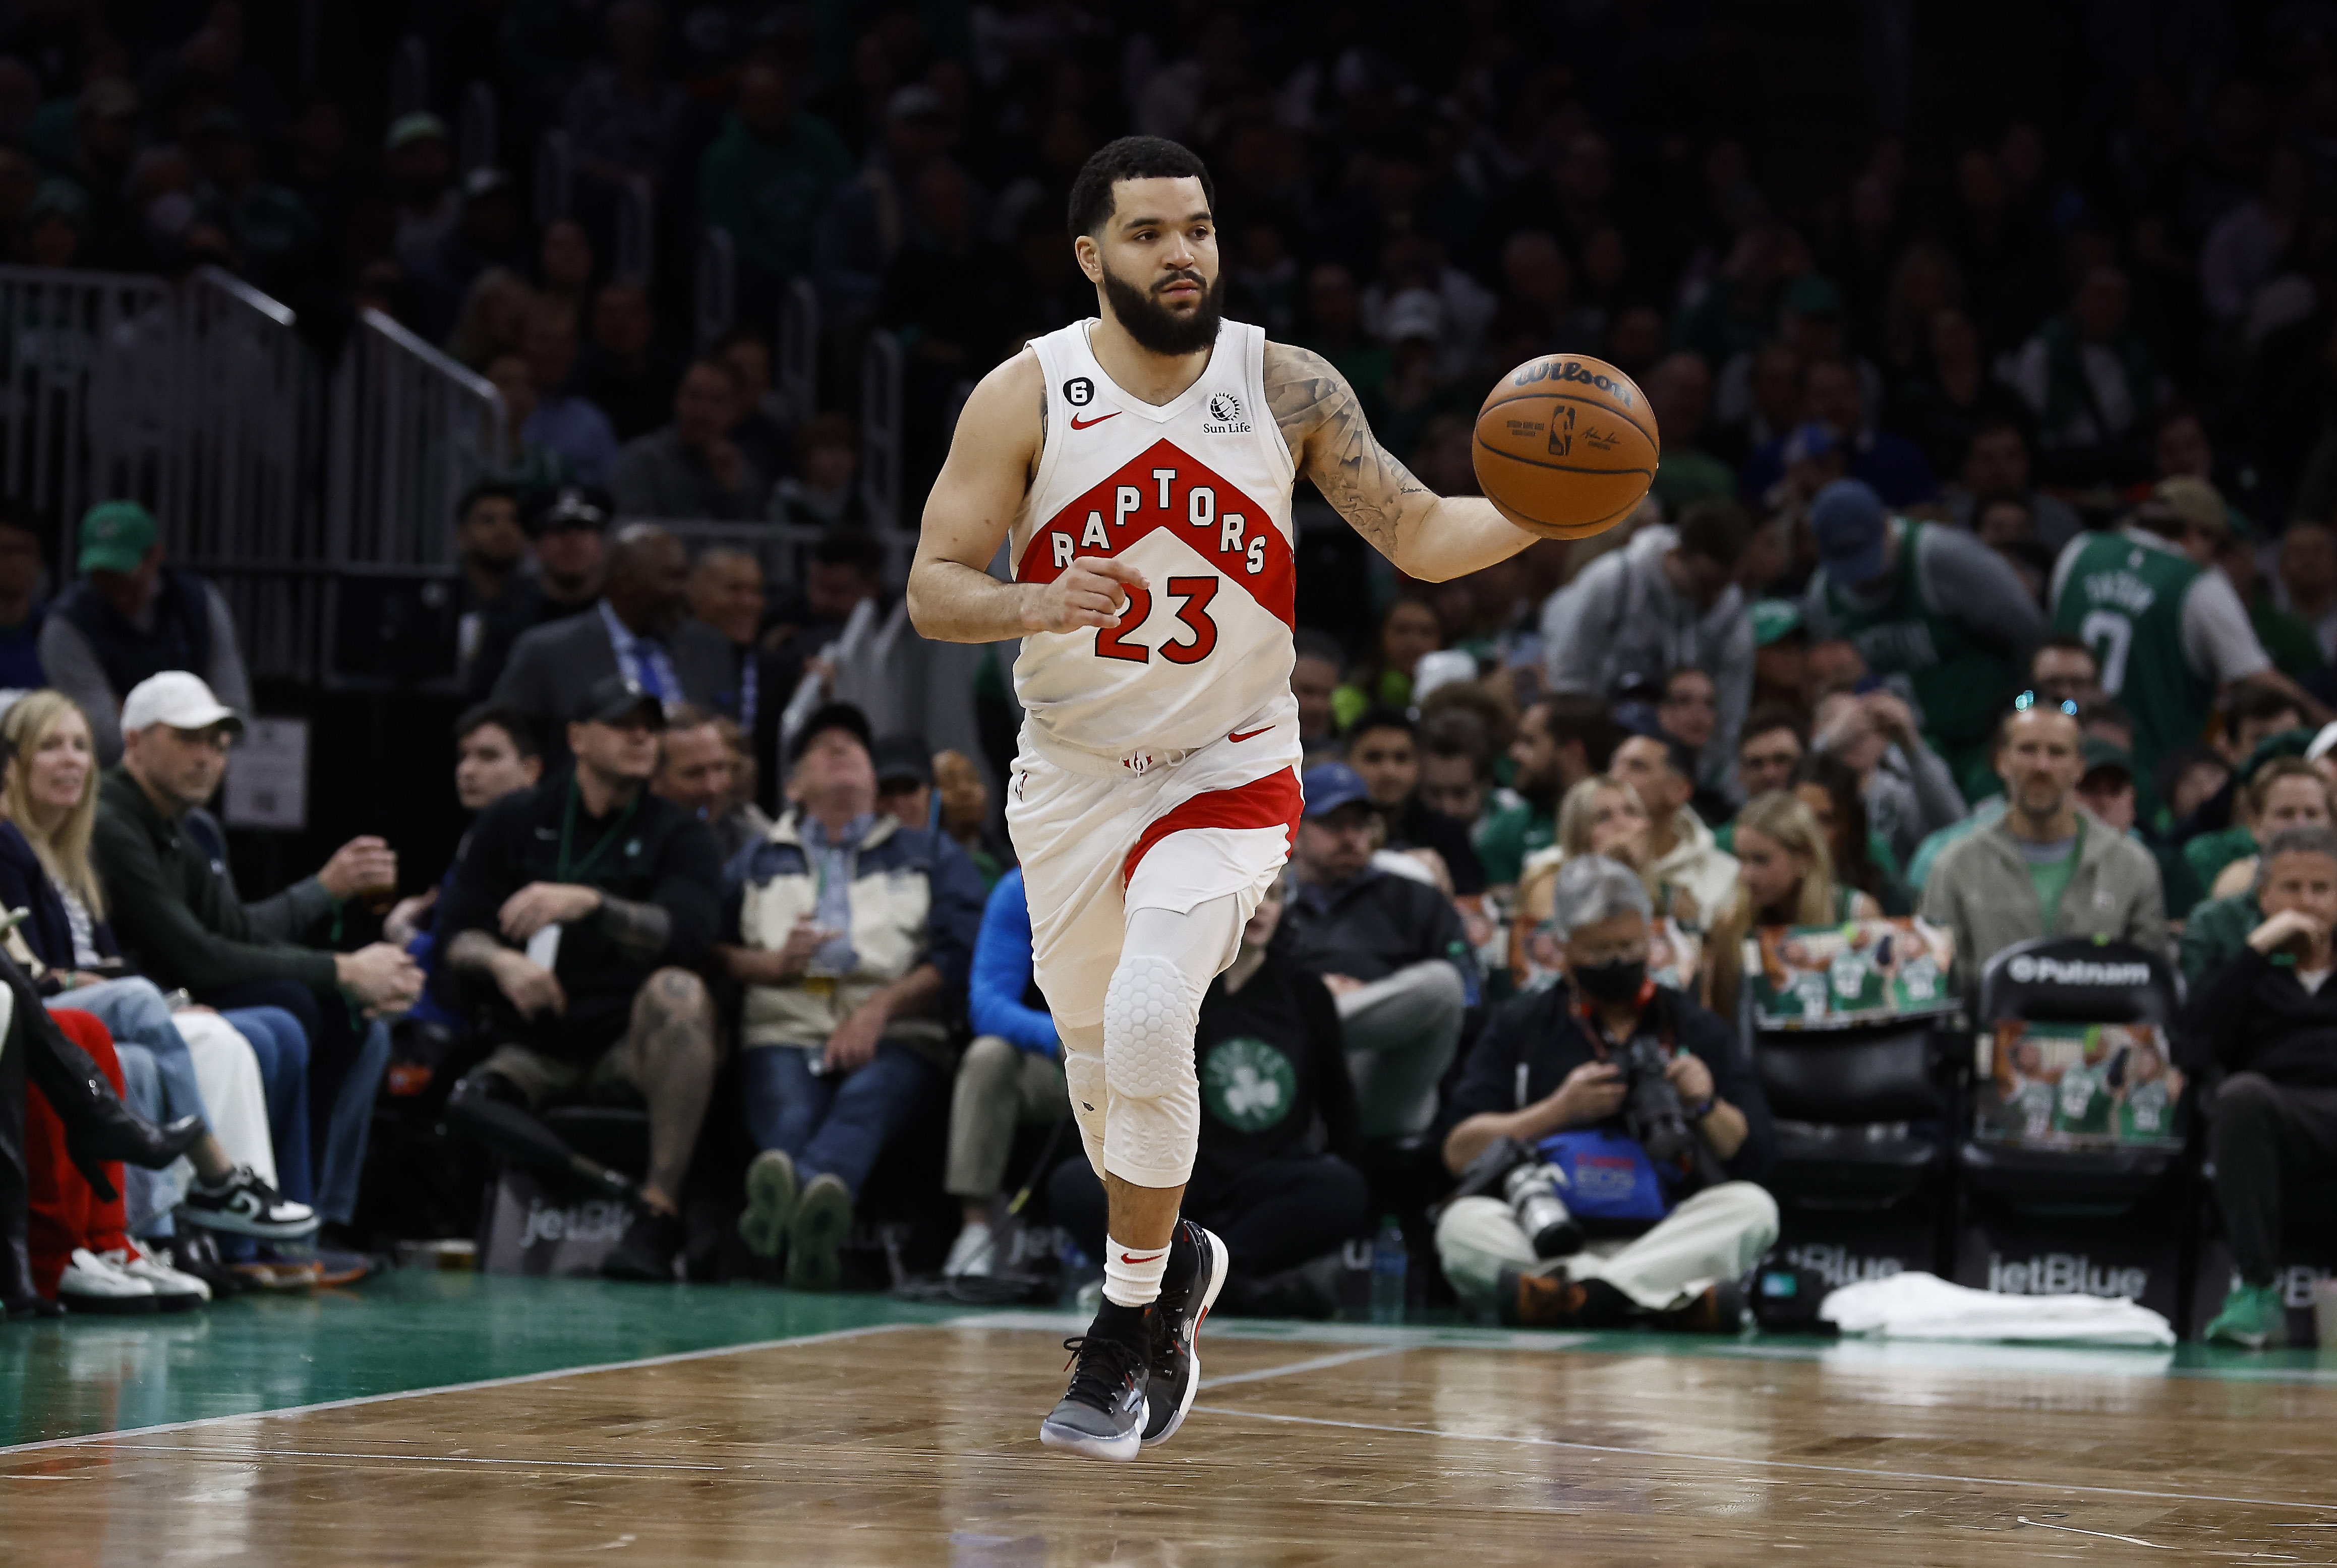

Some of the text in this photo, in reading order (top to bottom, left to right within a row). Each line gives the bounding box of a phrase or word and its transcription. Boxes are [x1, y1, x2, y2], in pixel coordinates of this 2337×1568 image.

[1070, 381, 1088, 403] 6
[1203, 422, 1251, 433] Sun Life
[1051, 468, 1266, 574] RAPTORS
[1095, 576, 1219, 664] 23
[2037, 957, 2150, 985] Putnam
[1988, 1250, 2148, 1298] jetBlue
